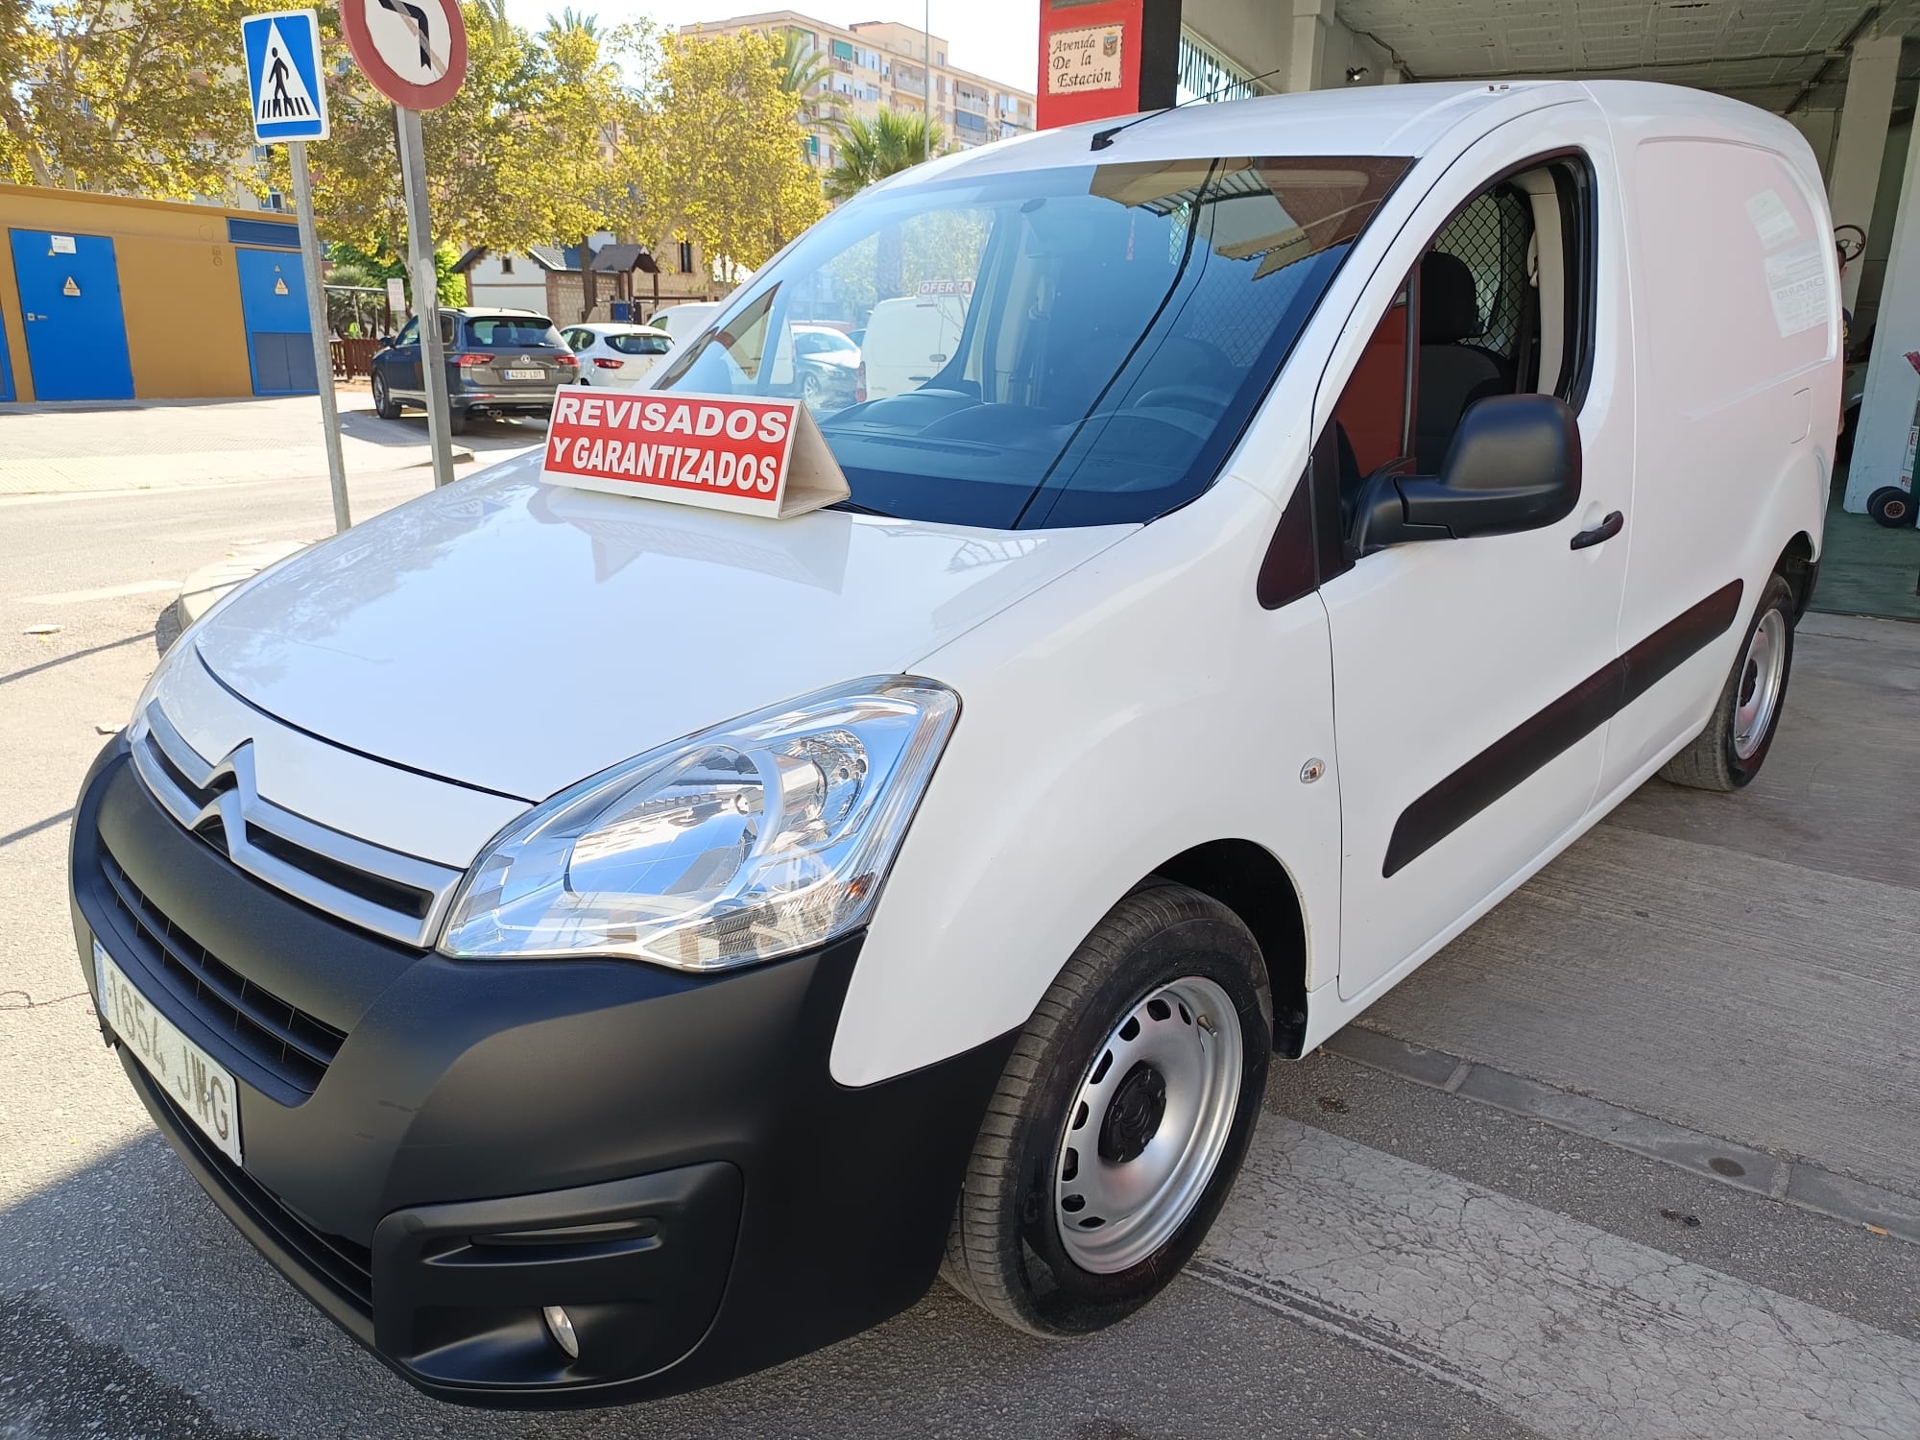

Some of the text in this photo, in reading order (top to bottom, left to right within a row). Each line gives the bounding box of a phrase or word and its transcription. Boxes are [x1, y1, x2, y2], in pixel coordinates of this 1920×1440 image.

[1052, 34, 1096, 54] Avenida
[1052, 49, 1092, 70] De la
[1057, 67, 1112, 88] Estación
[555, 397, 787, 444] REVISADOS
[552, 436, 777, 493] Y GARANTIZADOS
[108, 970, 229, 1141] 1654 JWG
